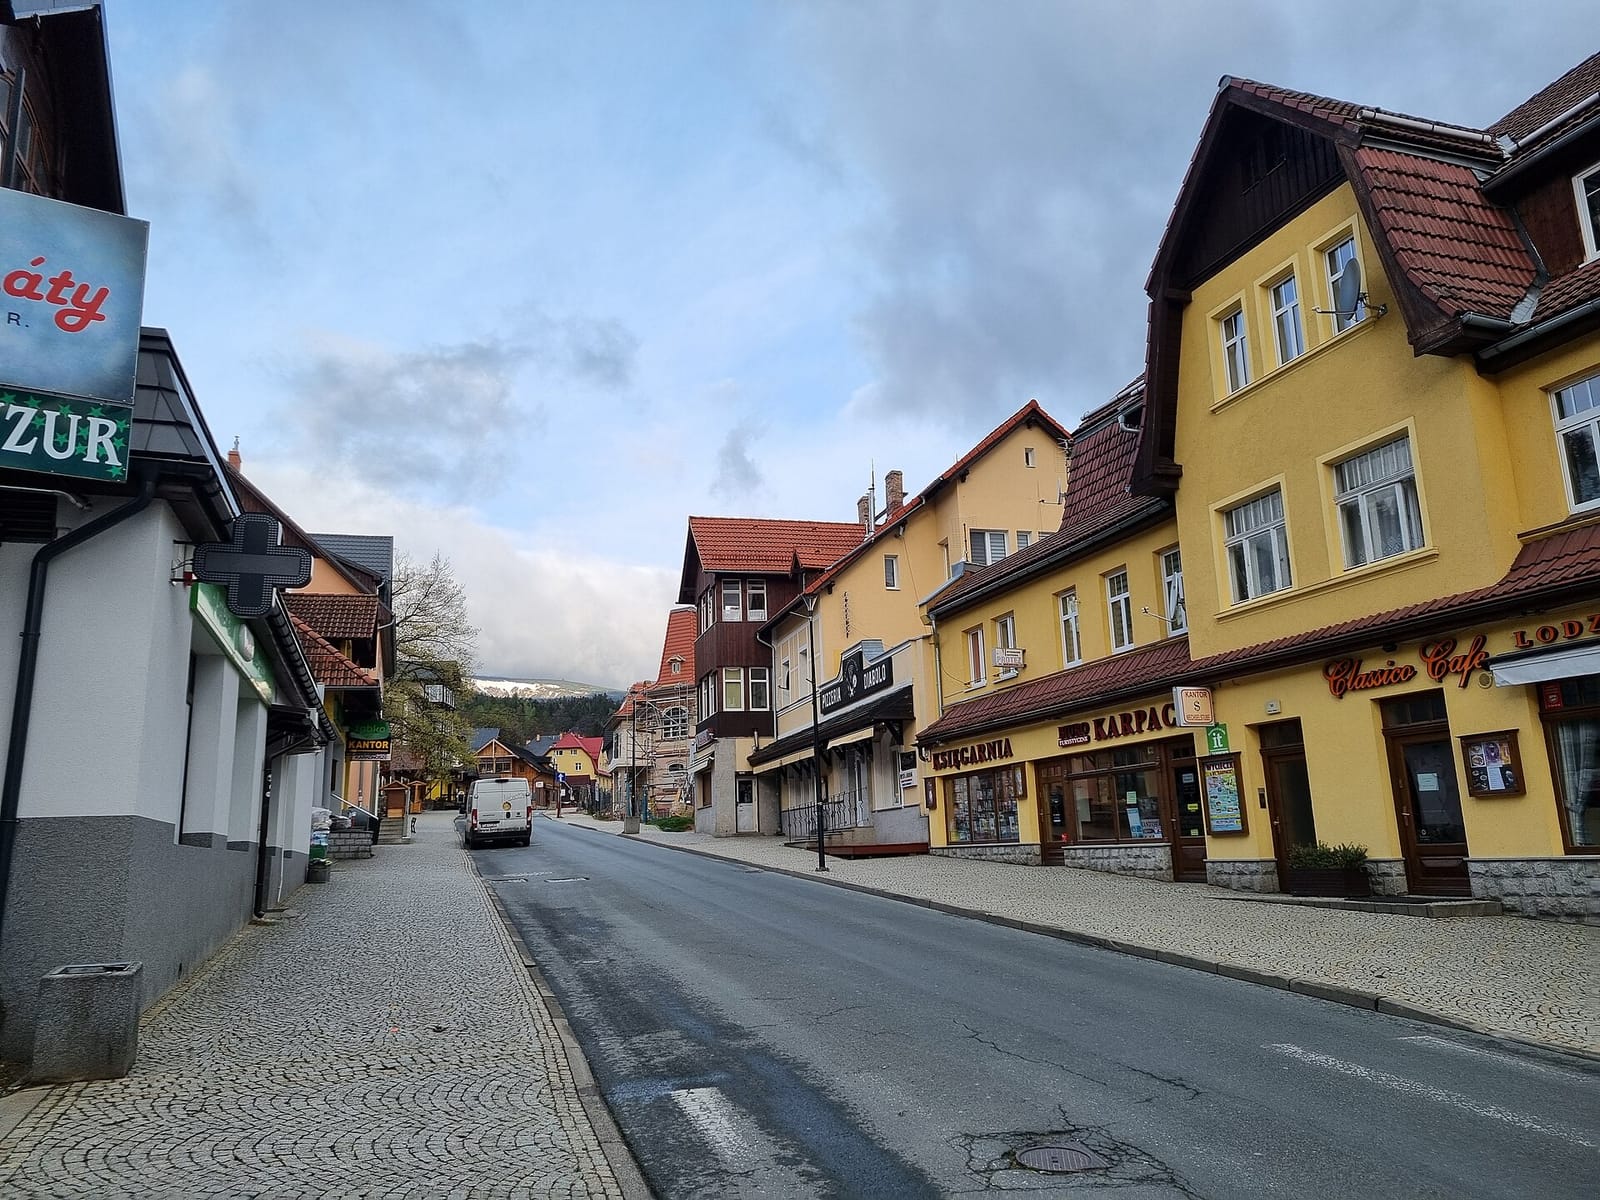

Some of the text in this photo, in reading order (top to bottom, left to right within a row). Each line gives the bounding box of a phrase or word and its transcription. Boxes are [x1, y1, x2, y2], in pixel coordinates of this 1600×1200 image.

[0, 402, 122, 467] ZUR
[1184, 691, 1208, 699] KANTOR
[1323, 658, 1418, 699] Classico
[1092, 702, 1176, 741] KARPAC
[348, 740, 389, 749] KANTOR
[932, 737, 1014, 771] KSIĘGARNIA
[1213, 732, 1223, 748] it
